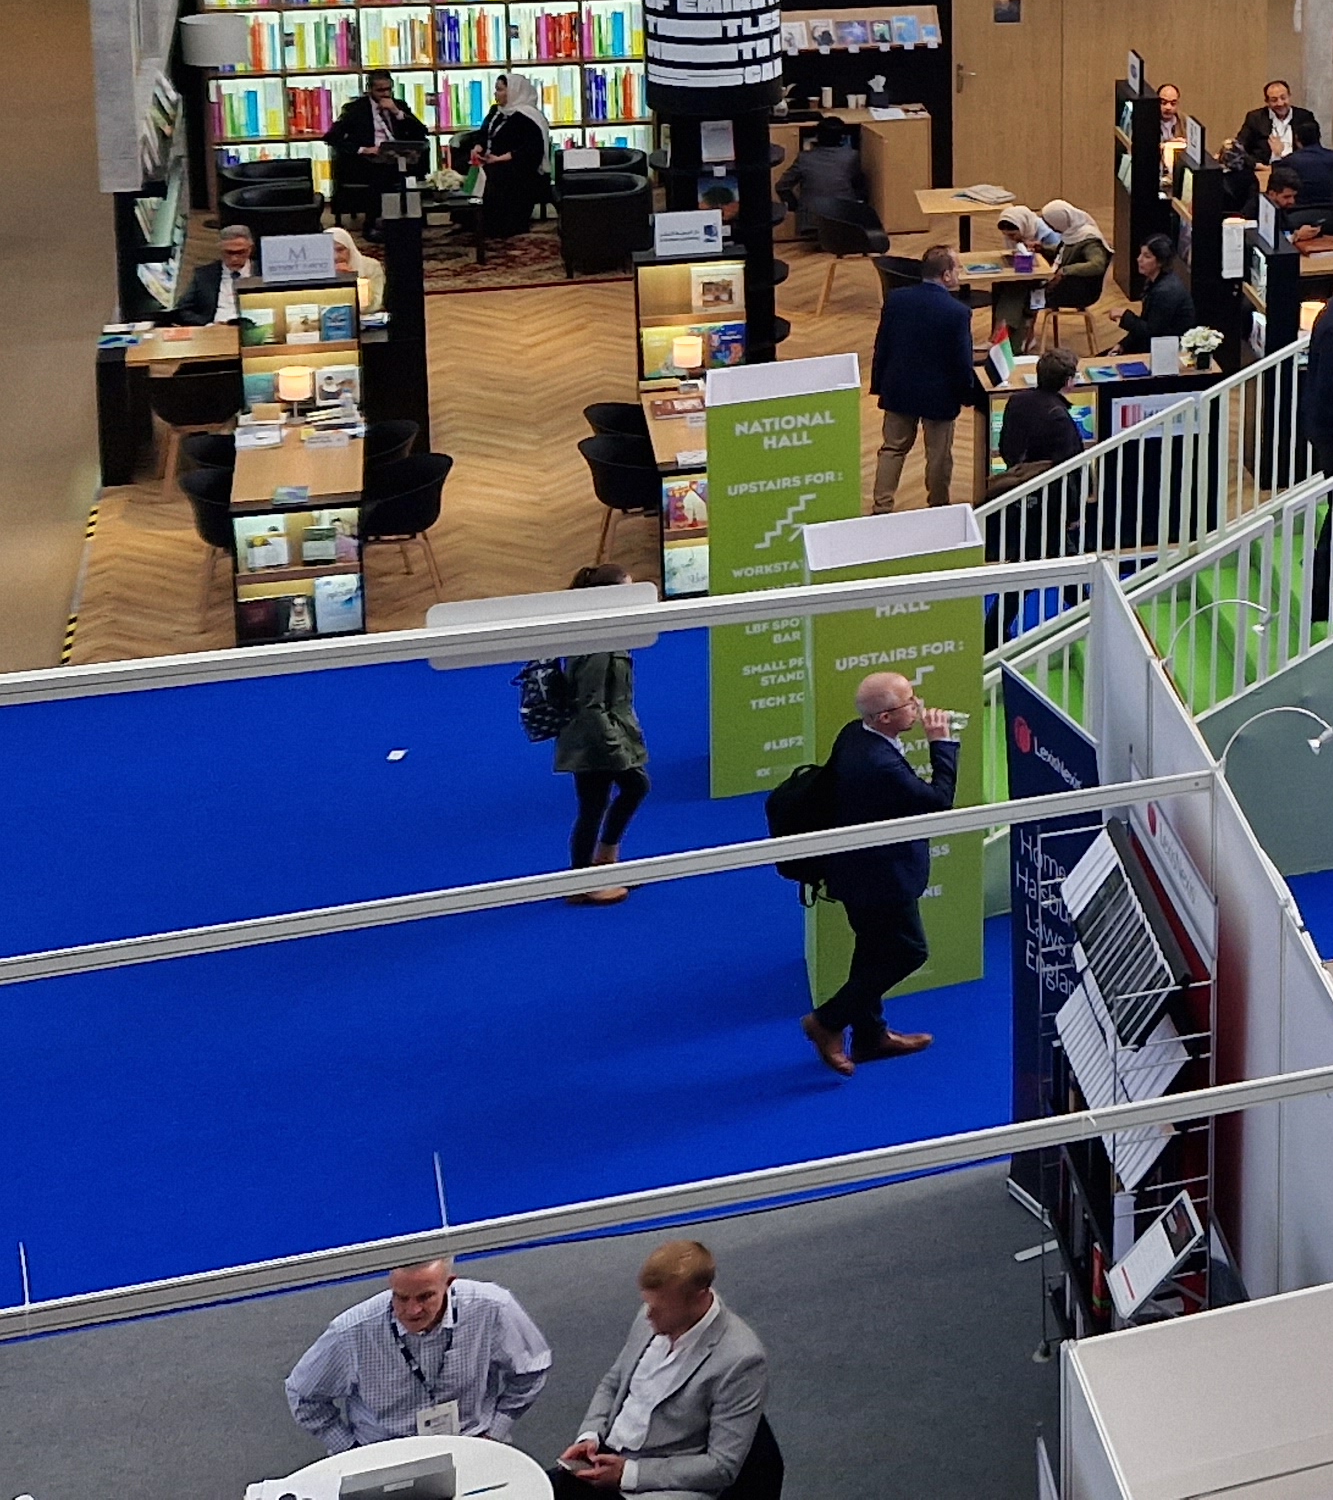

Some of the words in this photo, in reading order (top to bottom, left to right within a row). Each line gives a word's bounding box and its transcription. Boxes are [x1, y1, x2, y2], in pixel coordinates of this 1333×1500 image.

[734, 410, 836, 437] NATIONAL
[763, 431, 813, 451] HALL
[727, 474, 801, 497] UPSTAIRS
[804, 471, 836, 485] FOR
[731, 560, 804, 579] WORKSTA
[745, 622, 770, 637] LBF
[771, 617, 804, 632] SPO
[772, 631, 801, 645] BAR
[835, 645, 918, 672] UPSTAIRS
[921, 640, 956, 656] FOR
[742, 660, 787, 678] SMALL
[750, 694, 787, 710] TECH
[1025, 939, 1080, 998] Englan
